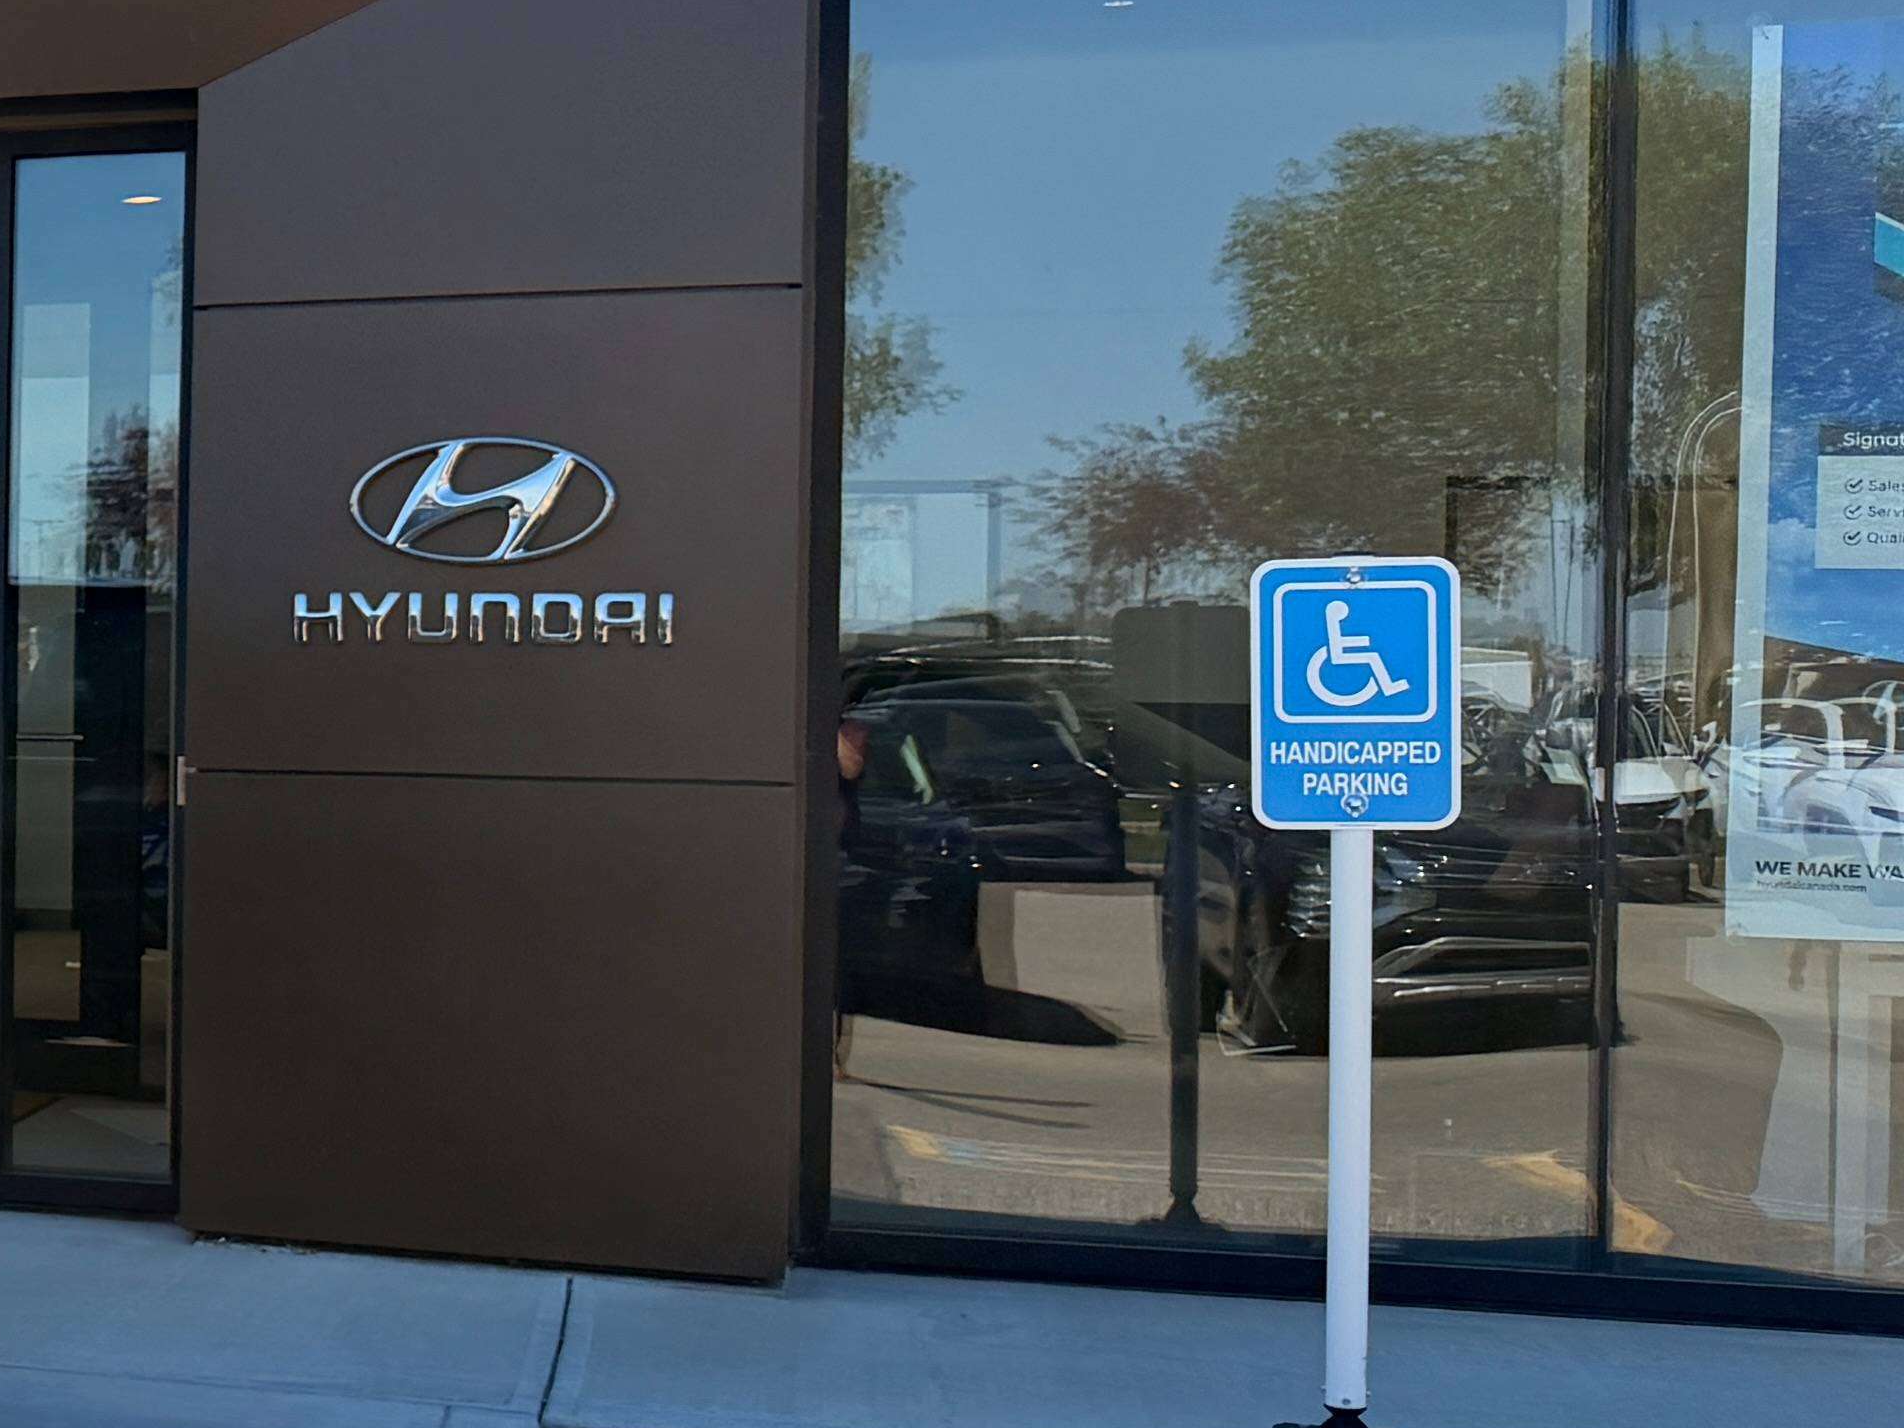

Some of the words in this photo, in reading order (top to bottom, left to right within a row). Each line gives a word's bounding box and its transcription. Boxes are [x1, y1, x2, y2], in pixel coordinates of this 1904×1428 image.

[293, 591, 674, 645] HYUNDAI
[1270, 741, 1442, 765] HANDICAPPED
[1303, 772, 1408, 796] PARKING
[1755, 860, 1792, 875] WE
[1797, 861, 1862, 878] MAKE
